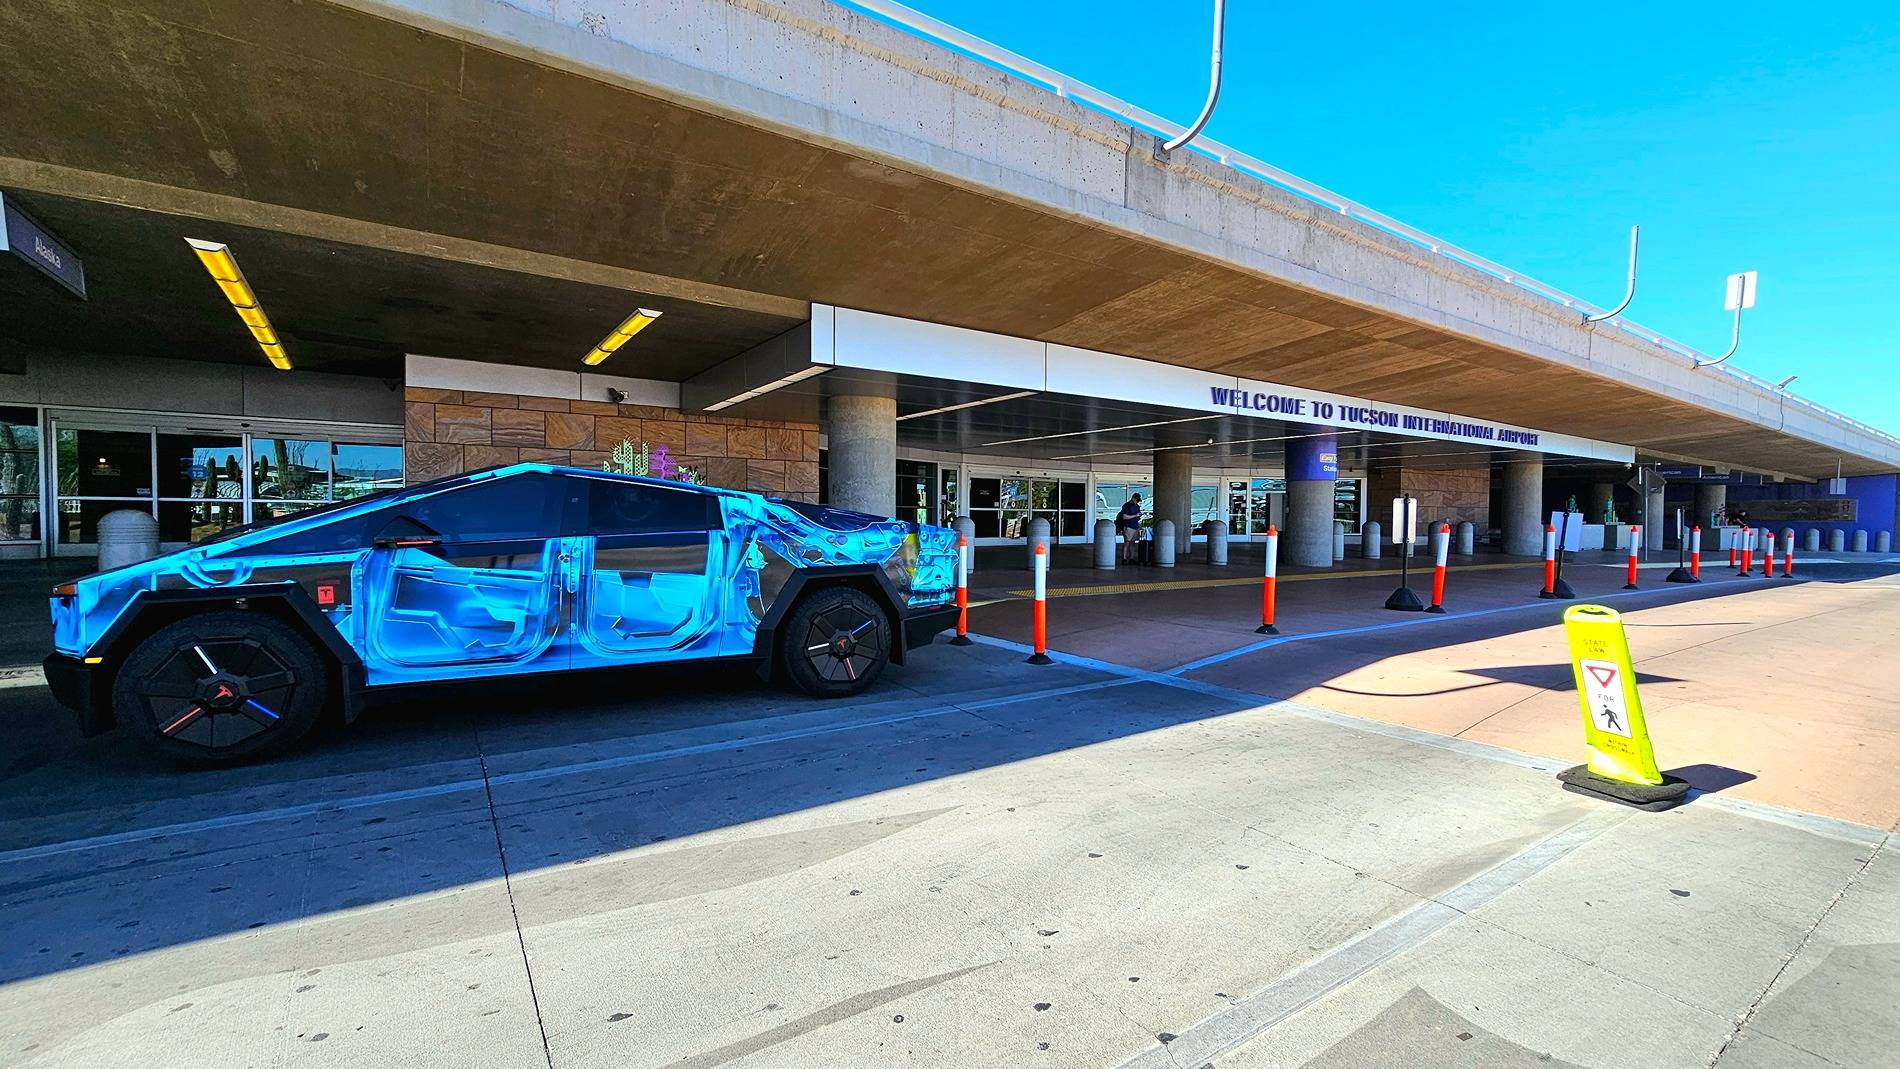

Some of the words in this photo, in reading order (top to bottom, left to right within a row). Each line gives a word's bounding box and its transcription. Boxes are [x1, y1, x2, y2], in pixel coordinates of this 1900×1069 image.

[35, 236, 62, 269] Alaska
[1211, 386, 1306, 416] WELCOME
[1311, 400, 1334, 420] TO
[1338, 404, 1399, 428] TUCSON
[1403, 414, 1496, 441] INTERNATIONAL
[1497, 428, 1541, 447] AIRPORT
